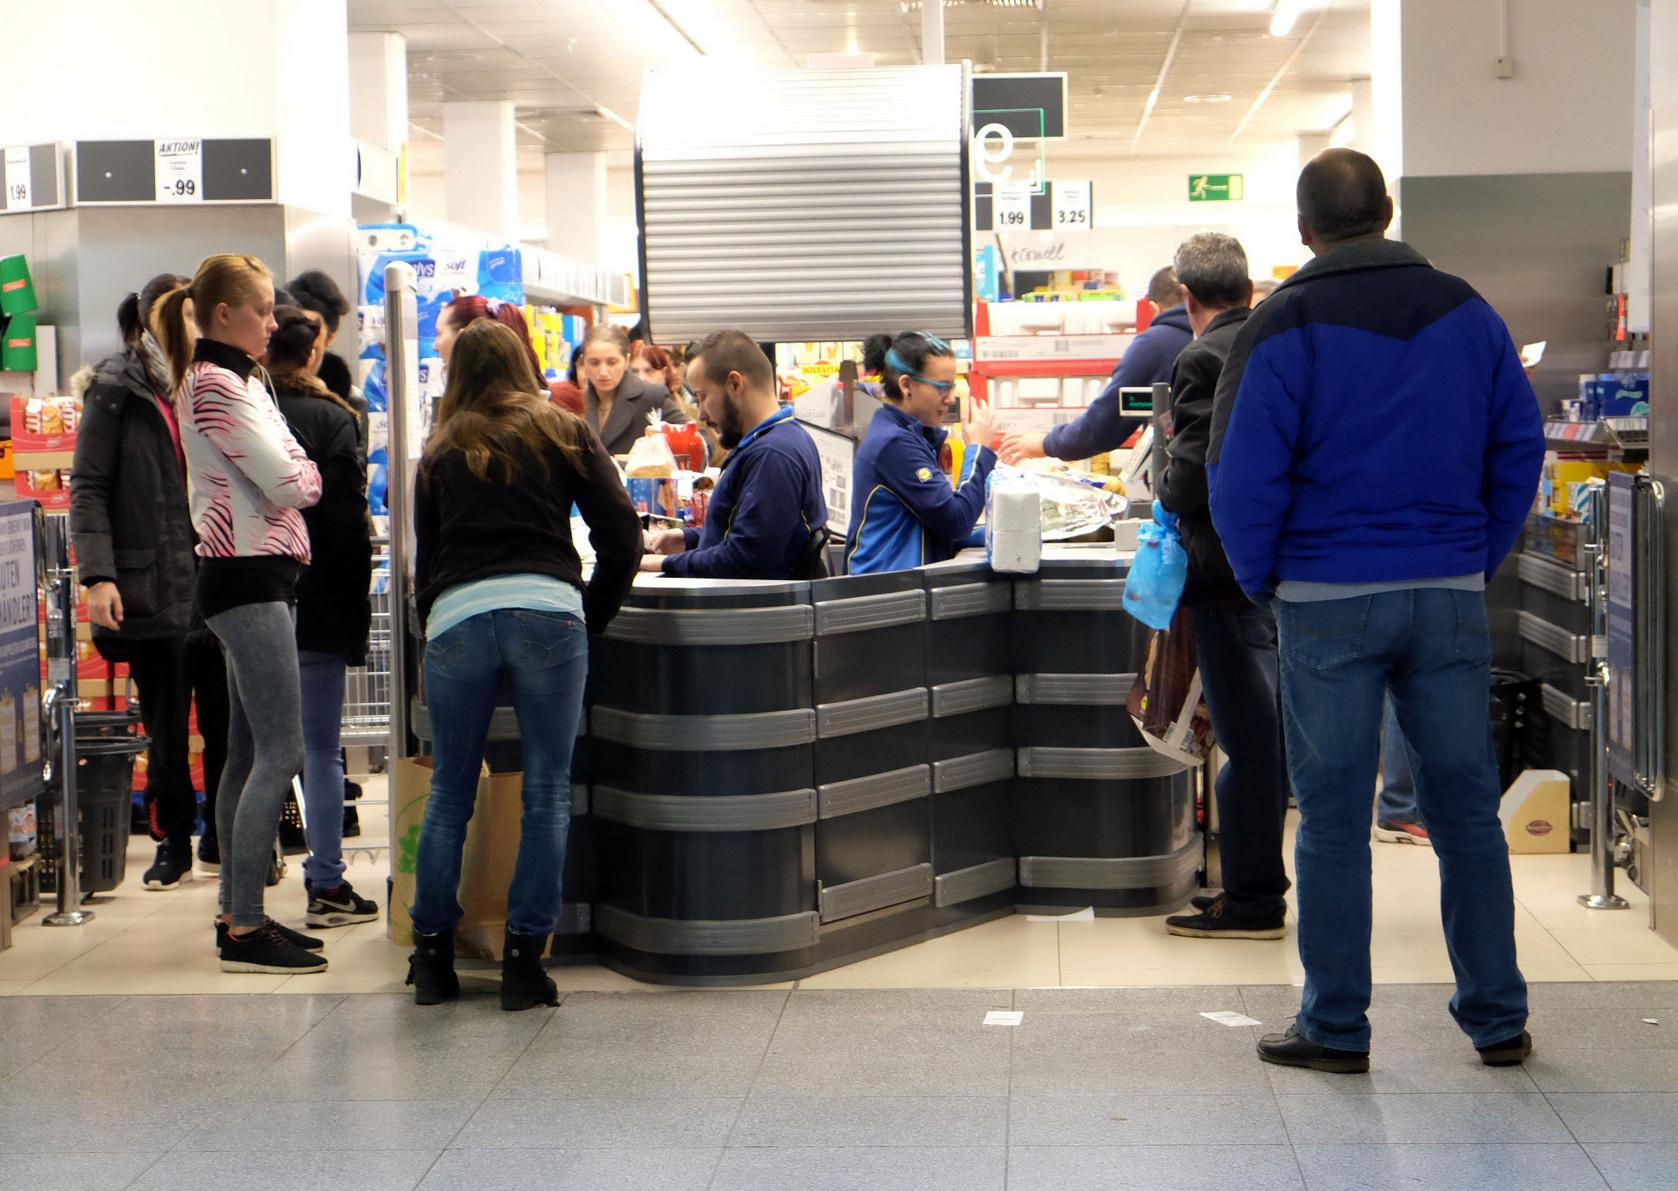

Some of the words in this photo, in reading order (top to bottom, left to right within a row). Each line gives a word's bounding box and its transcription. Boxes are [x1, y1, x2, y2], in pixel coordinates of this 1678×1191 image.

[159, 141, 199, 154] AKTION!
[10, 184, 26, 200] 1.99
[1000, 212, 1024, 225] 1.99
[1058, 210, 1086, 223] 3.25
[444, 259, 466, 271] soft
